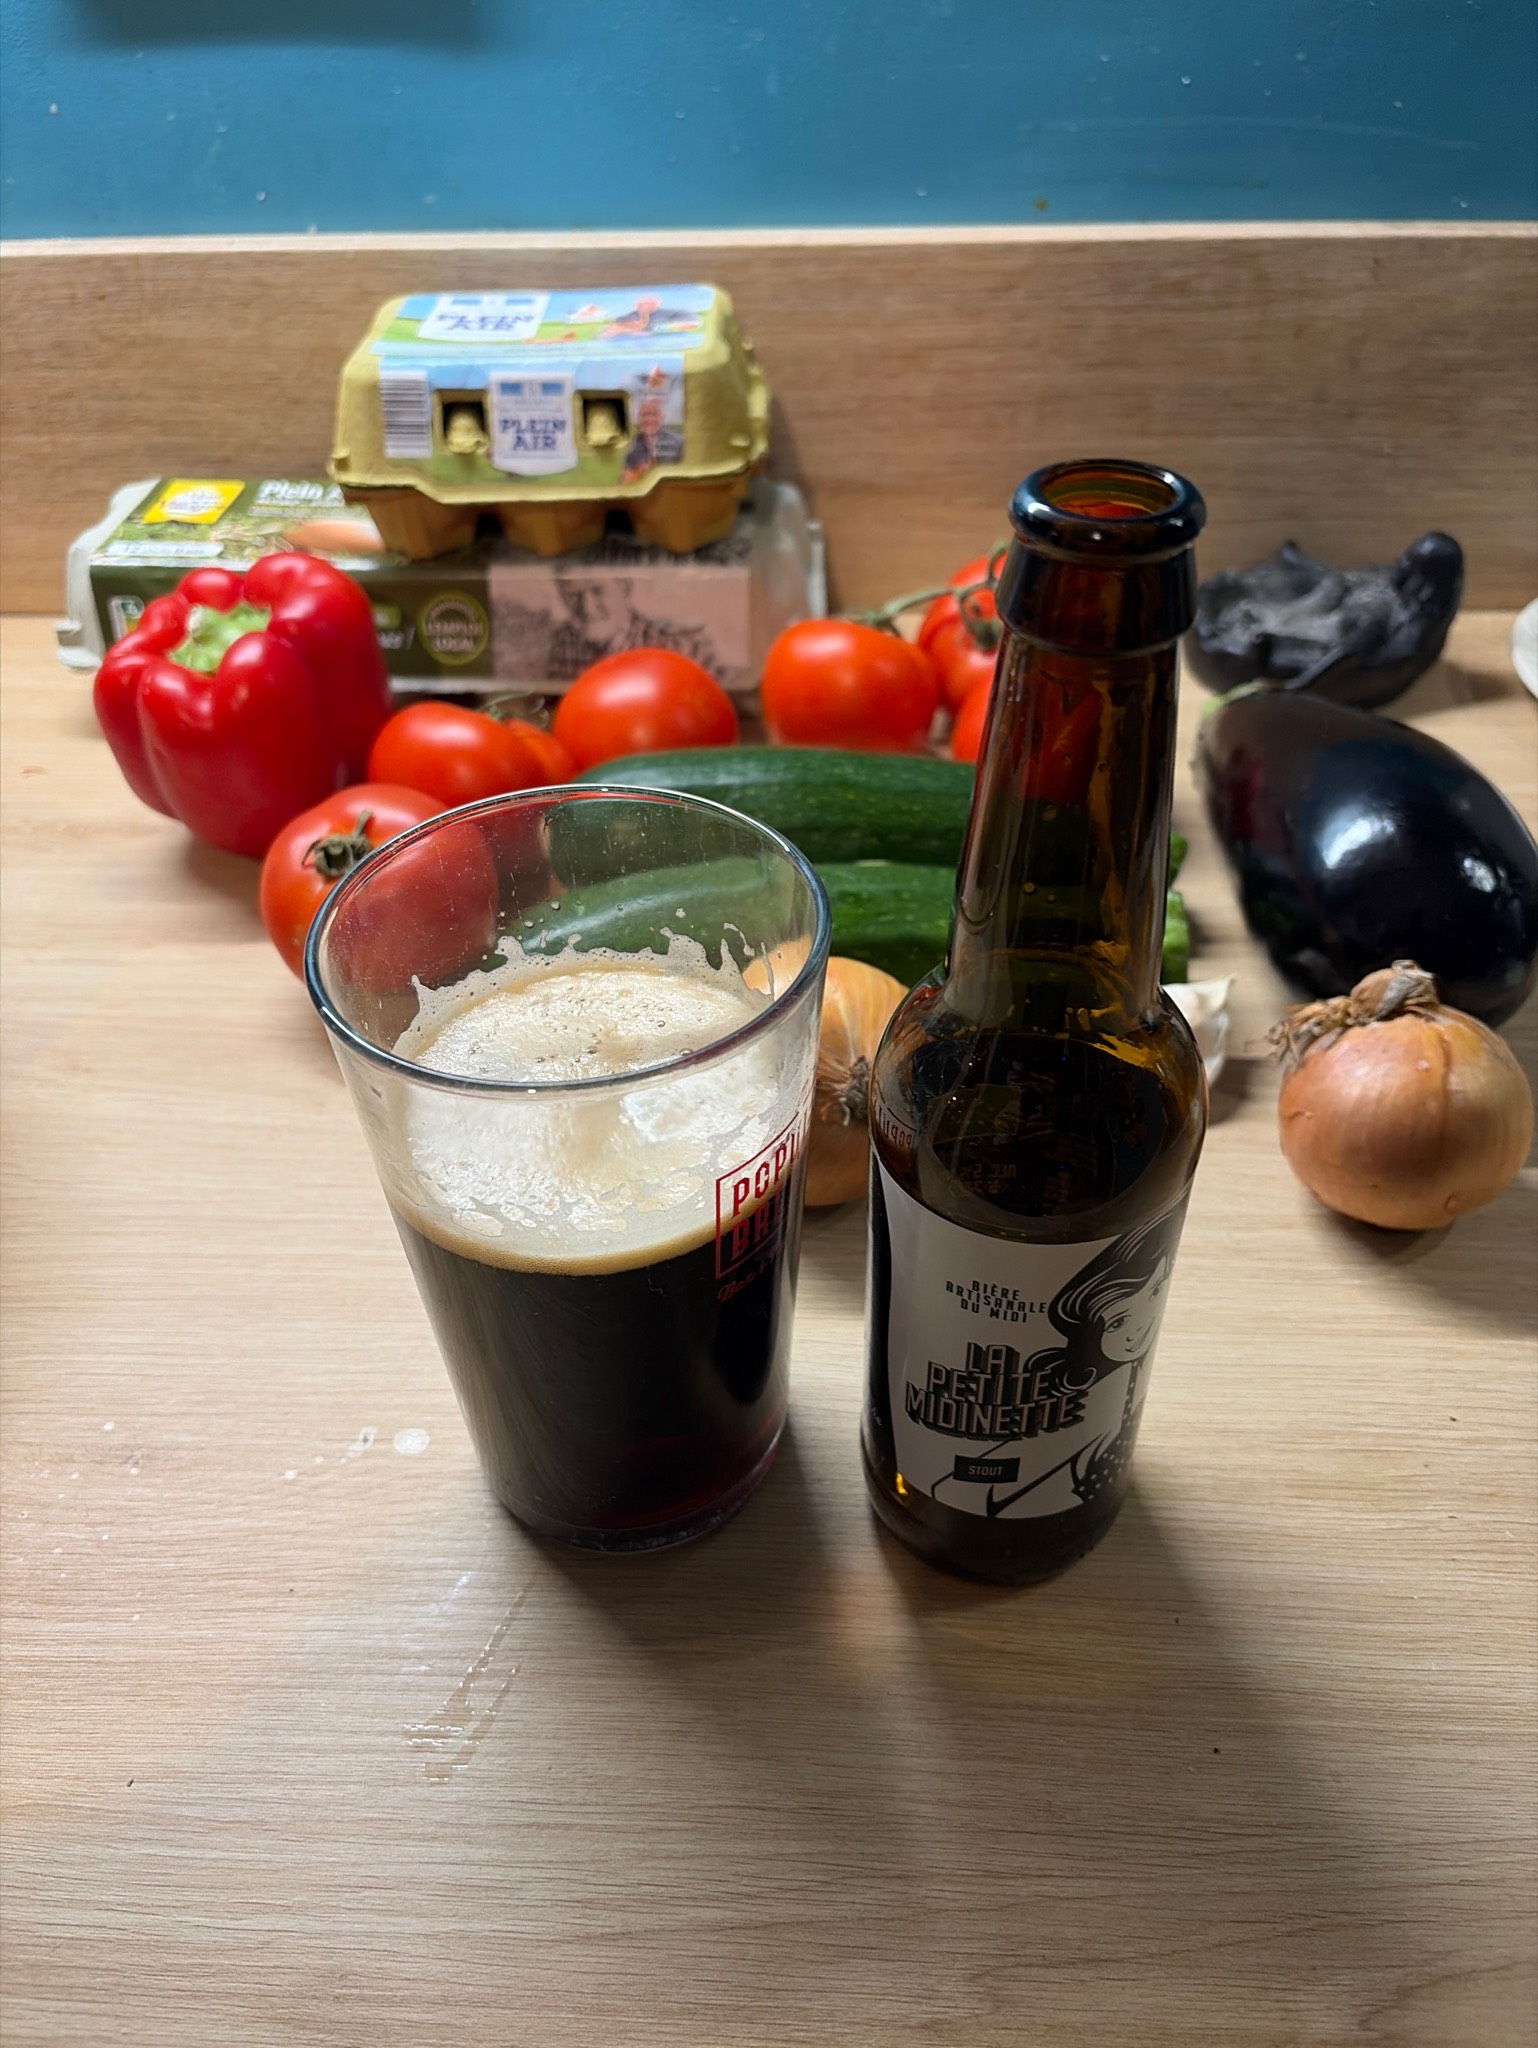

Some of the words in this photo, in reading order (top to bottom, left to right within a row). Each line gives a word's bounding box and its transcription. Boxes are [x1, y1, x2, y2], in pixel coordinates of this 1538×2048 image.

[500, 418, 566, 434] PLEIN
[513, 434, 556, 451] AIR
[257, 480, 324, 502] Plein
[946, 1281, 1047, 1313] ARTISANALE
[972, 1280, 1020, 1300] BIÈRE
[961, 1298, 979, 1313] DU
[989, 1307, 1027, 1323] MIDI
[966, 1342, 1018, 1374] LA
[928, 1361, 1052, 1404] PETITE
[905, 1381, 1087, 1440] MIDINETTE
[968, 1465, 1004, 1476] STOUT
